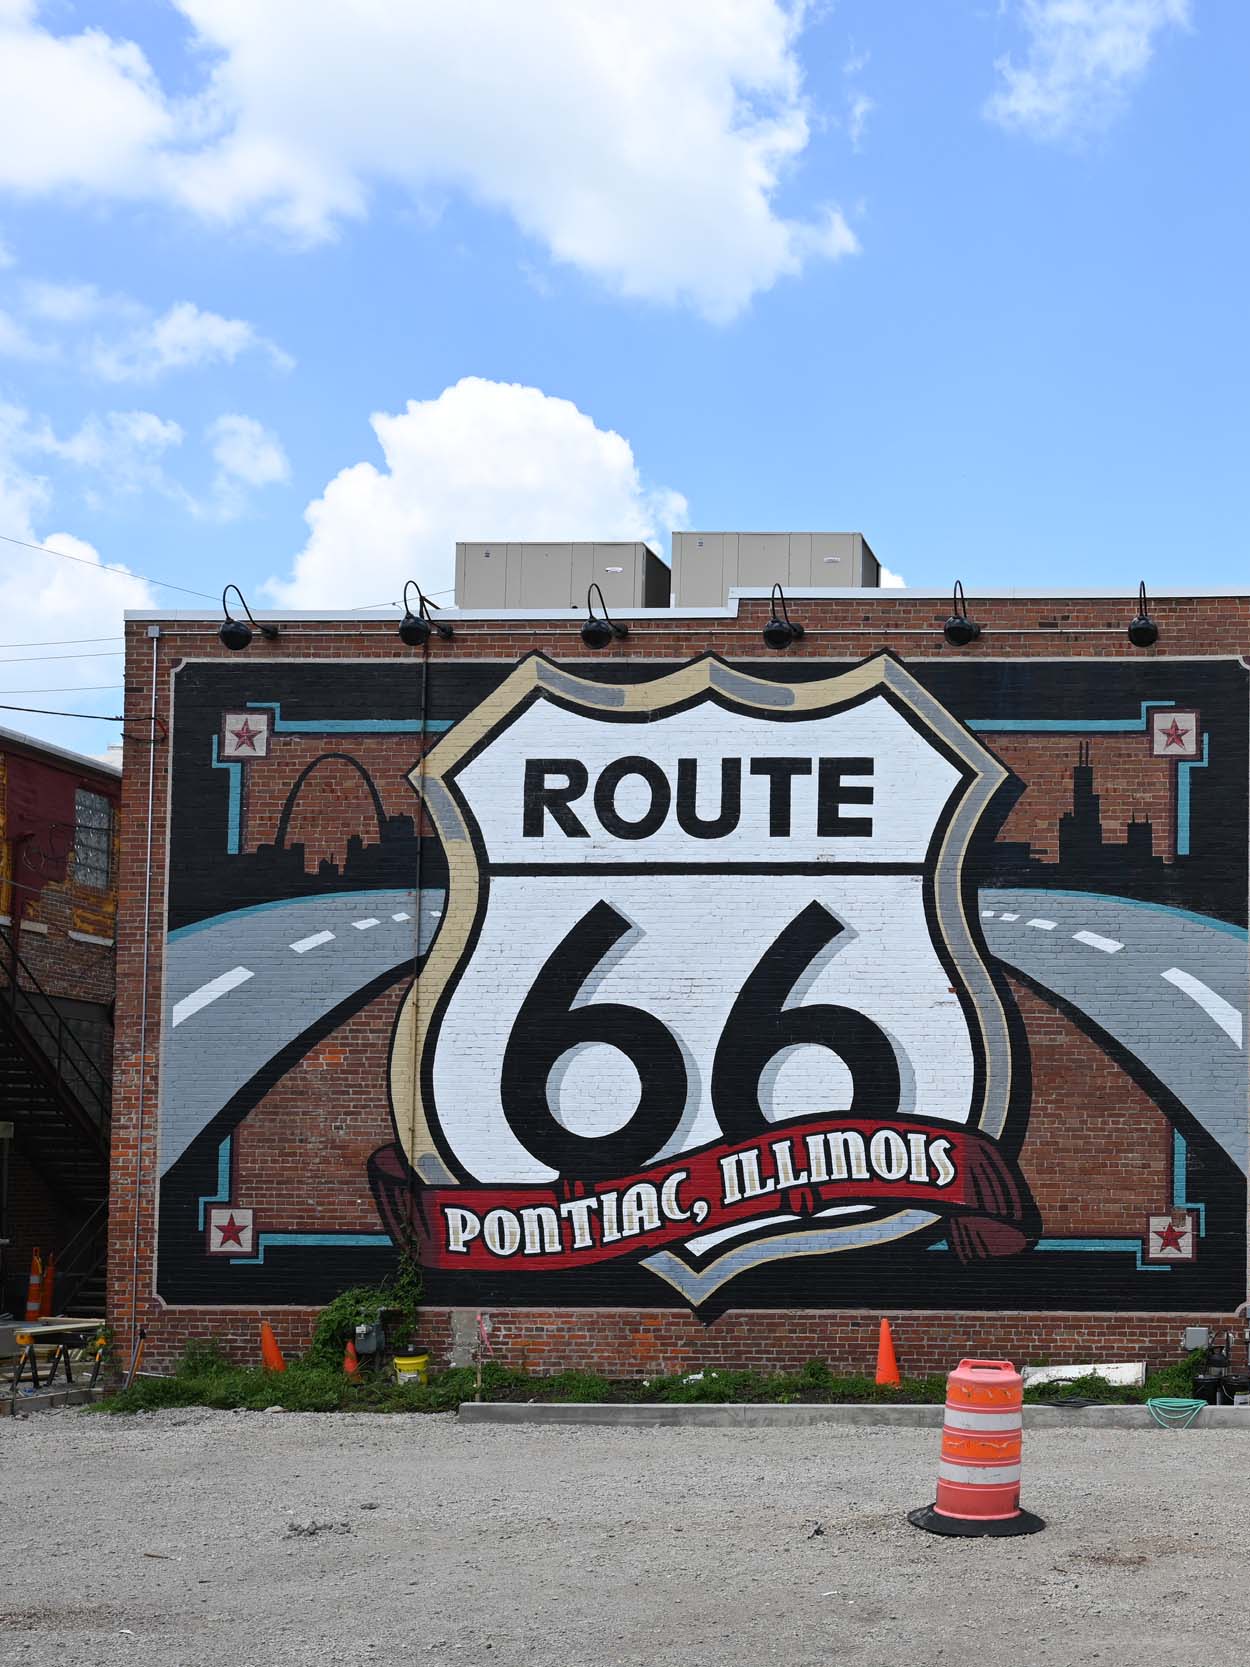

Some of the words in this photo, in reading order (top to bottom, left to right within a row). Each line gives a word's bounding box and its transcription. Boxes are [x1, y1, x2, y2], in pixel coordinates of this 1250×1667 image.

[522, 756, 874, 840] ROUTE
[500, 899, 902, 1175] 66
[719, 1128, 957, 1206] ILLINOIS
